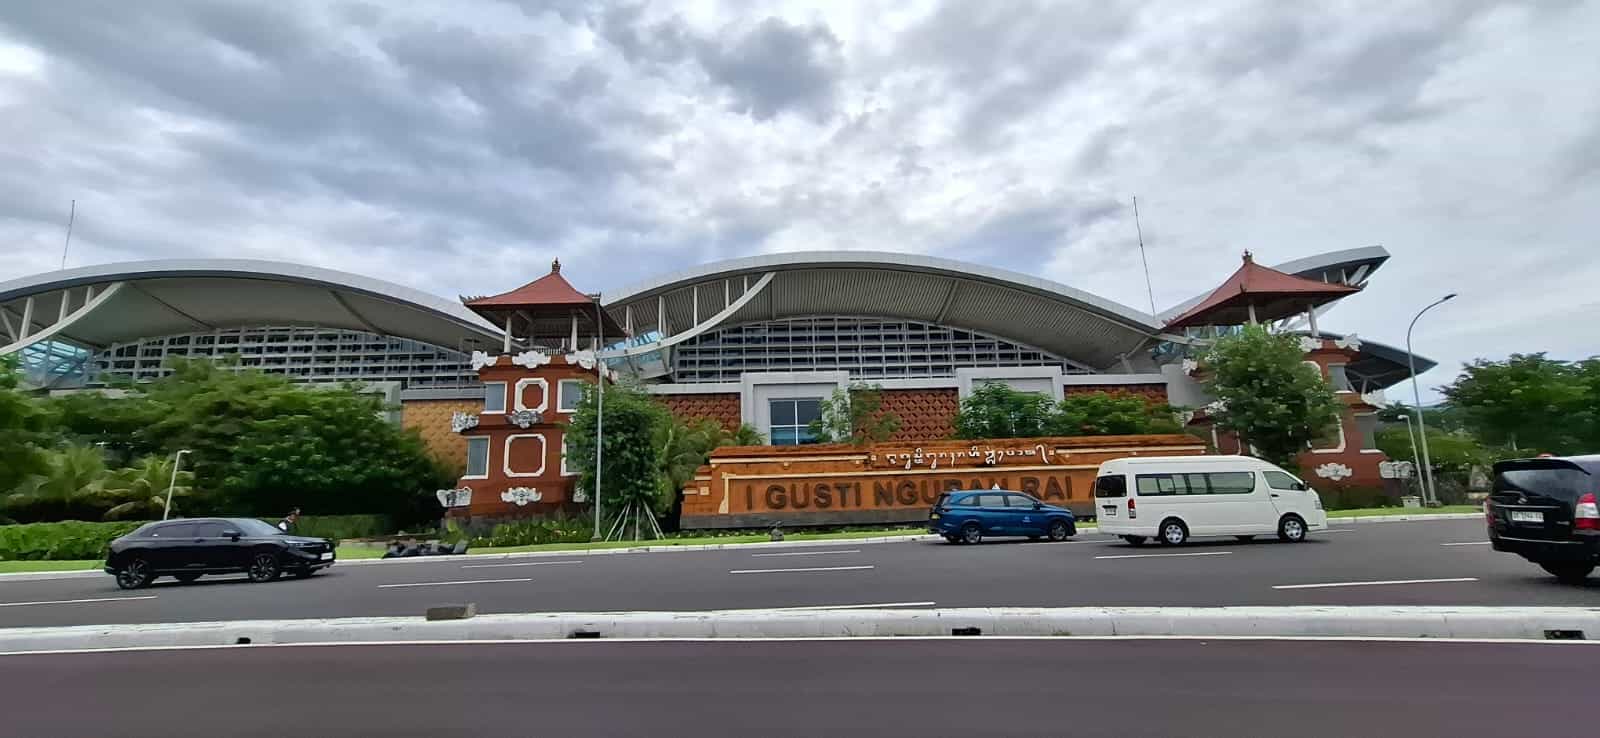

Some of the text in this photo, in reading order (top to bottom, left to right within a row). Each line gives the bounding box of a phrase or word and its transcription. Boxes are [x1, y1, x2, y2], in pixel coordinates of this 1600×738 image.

[746, 484, 753, 511] I
[765, 482, 861, 510] GUSTI
[1020, 475, 1073, 501] RAI
